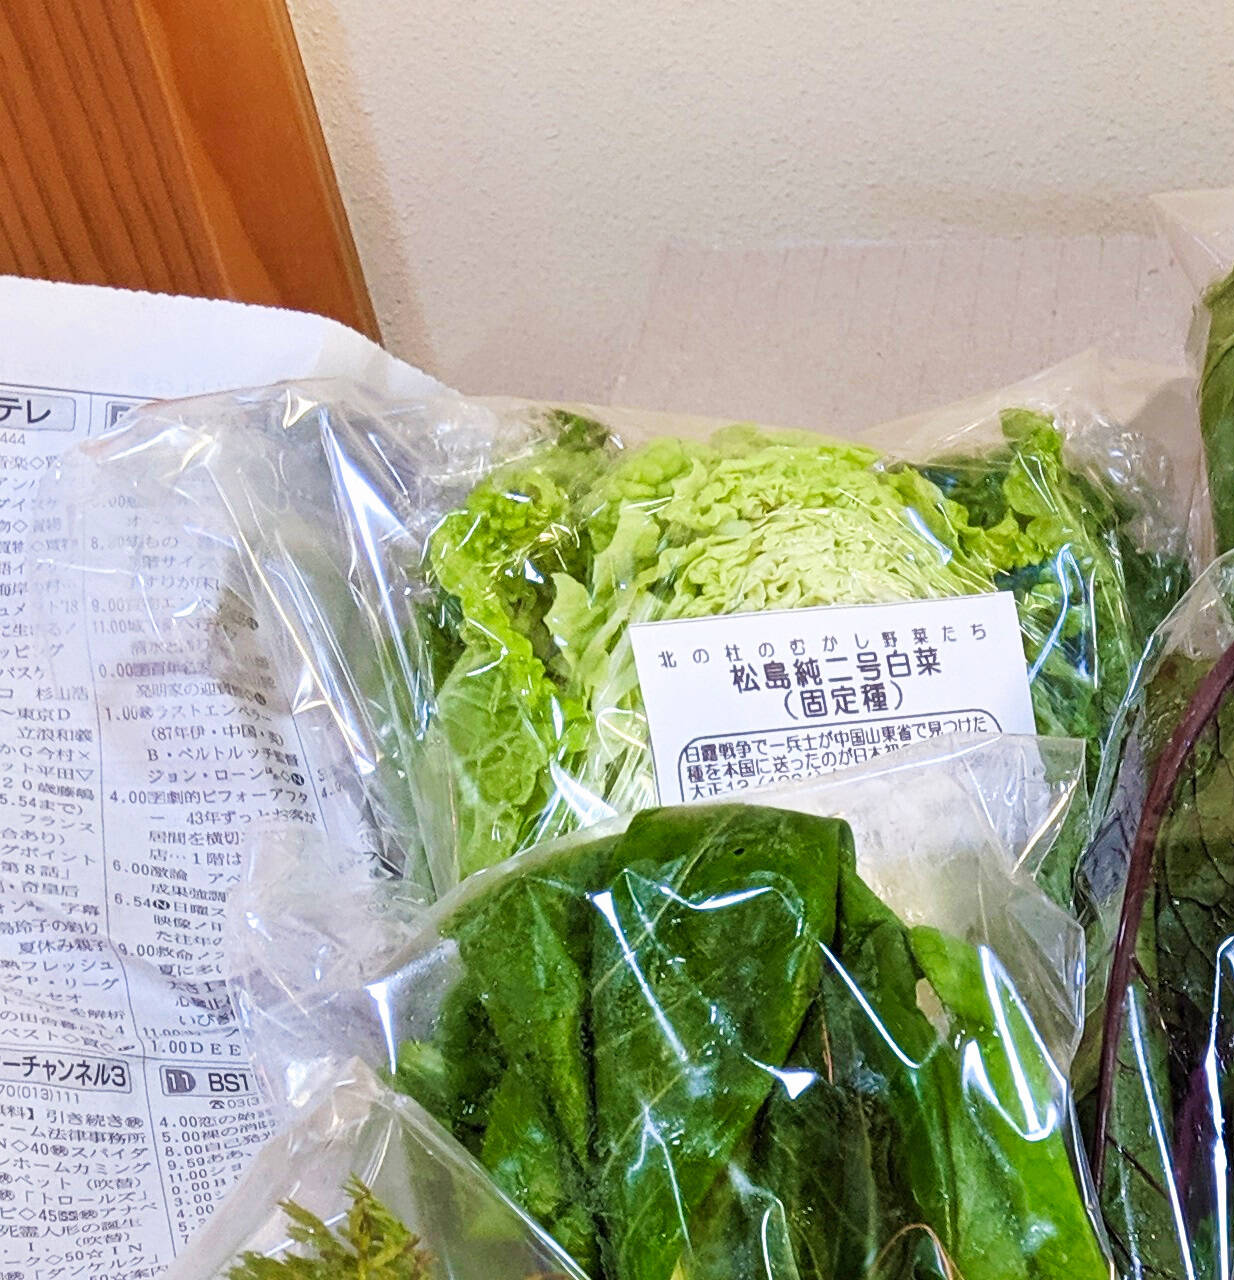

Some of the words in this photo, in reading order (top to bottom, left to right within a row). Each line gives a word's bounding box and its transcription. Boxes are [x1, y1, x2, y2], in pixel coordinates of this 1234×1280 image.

[659, 623, 987, 669] 北の杜のむかし野菜たち
[730, 646, 943, 694] 松島純二号白菜
[783, 681, 905, 721] （固定種）
